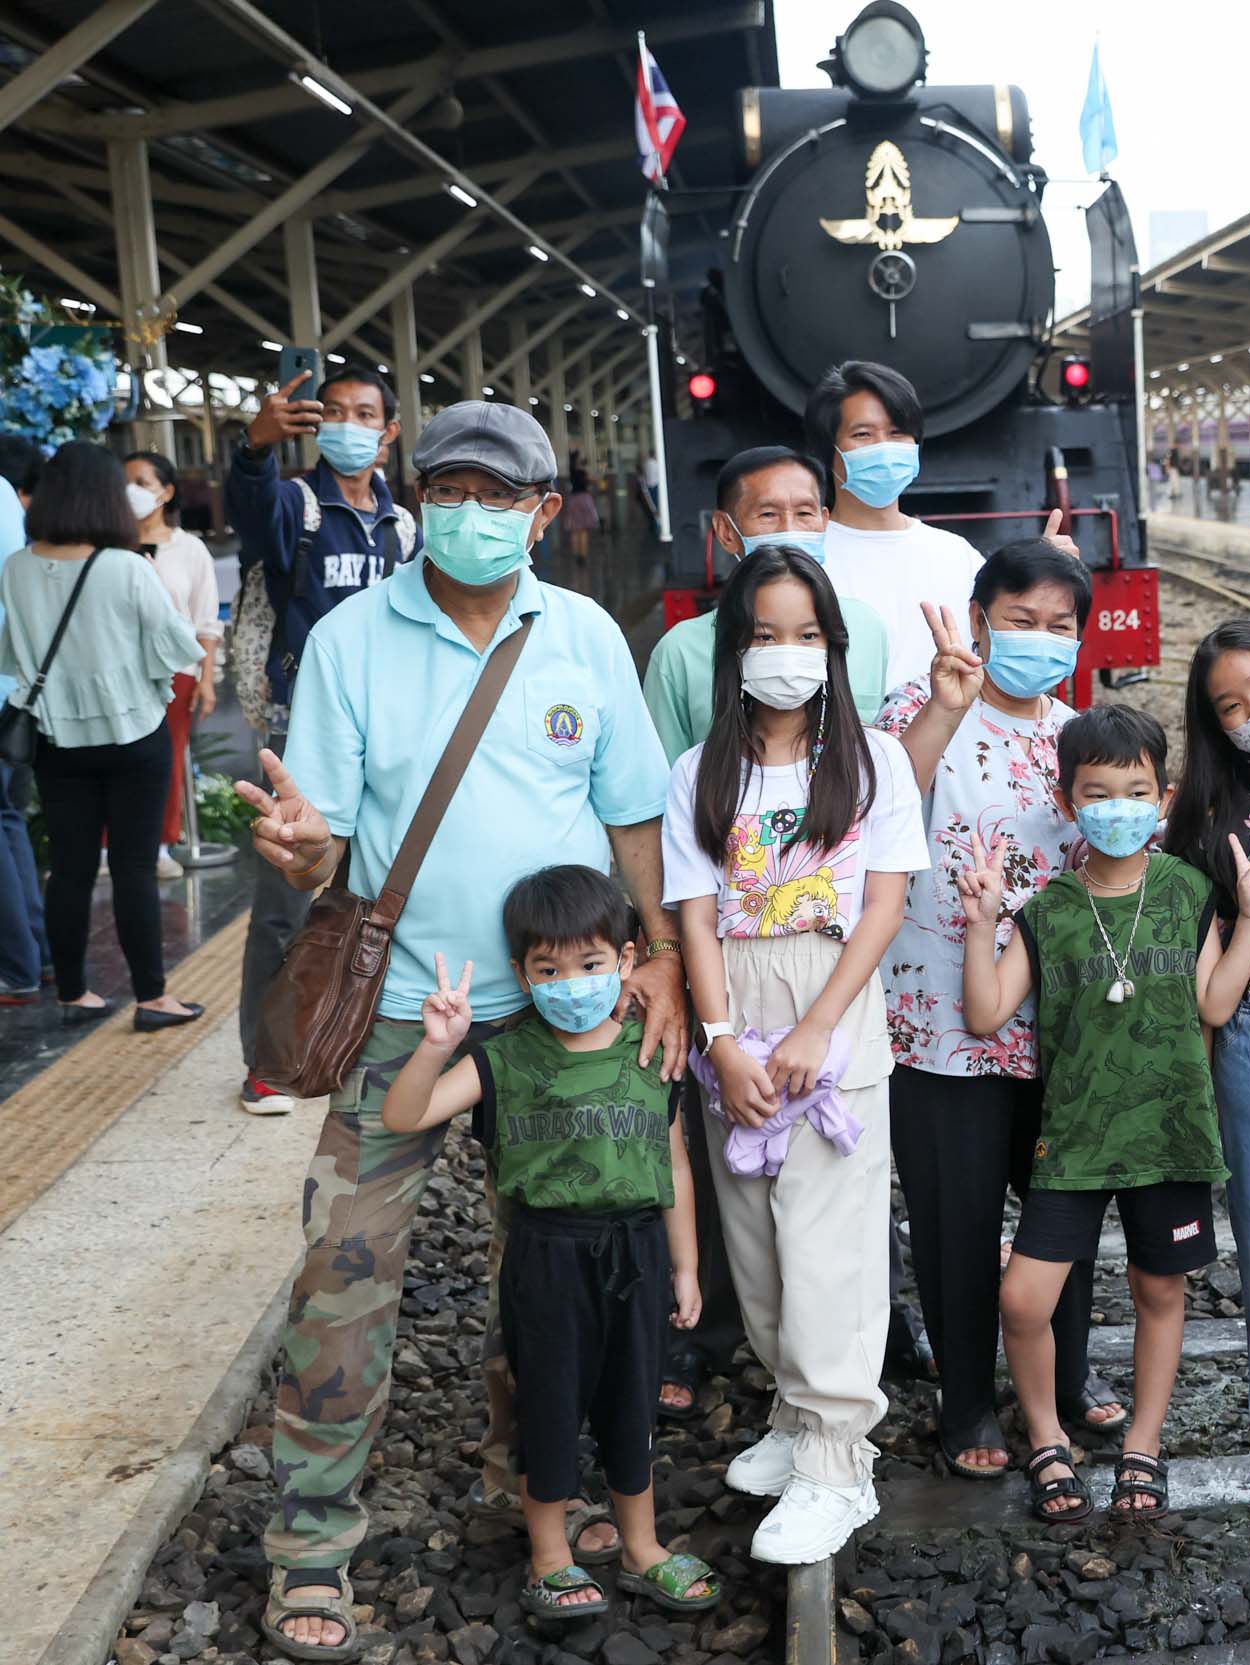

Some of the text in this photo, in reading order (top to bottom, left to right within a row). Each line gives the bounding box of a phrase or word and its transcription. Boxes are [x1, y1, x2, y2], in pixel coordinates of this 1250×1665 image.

[324, 553, 366, 588] BAY
[1098, 609, 1141, 631] 824
[507, 1108, 606, 1146] JURASSIC
[1173, 1220, 1200, 1242] MARVEL
